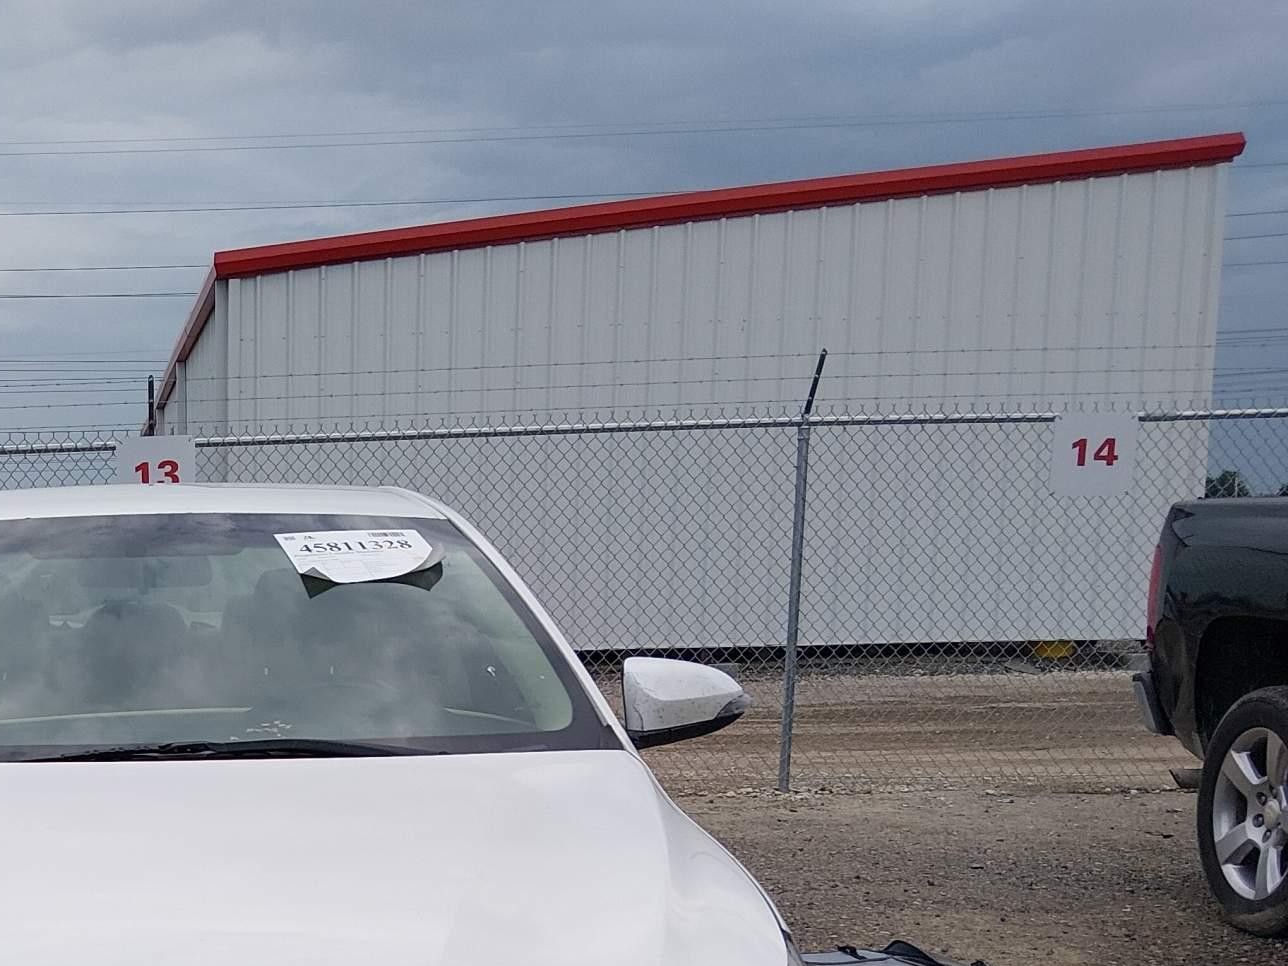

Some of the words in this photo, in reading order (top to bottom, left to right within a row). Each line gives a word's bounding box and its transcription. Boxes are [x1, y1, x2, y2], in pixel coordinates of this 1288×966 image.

[1072, 438, 1118, 466] 14
[135, 460, 180, 484] 13
[299, 539, 413, 553] 45811328
